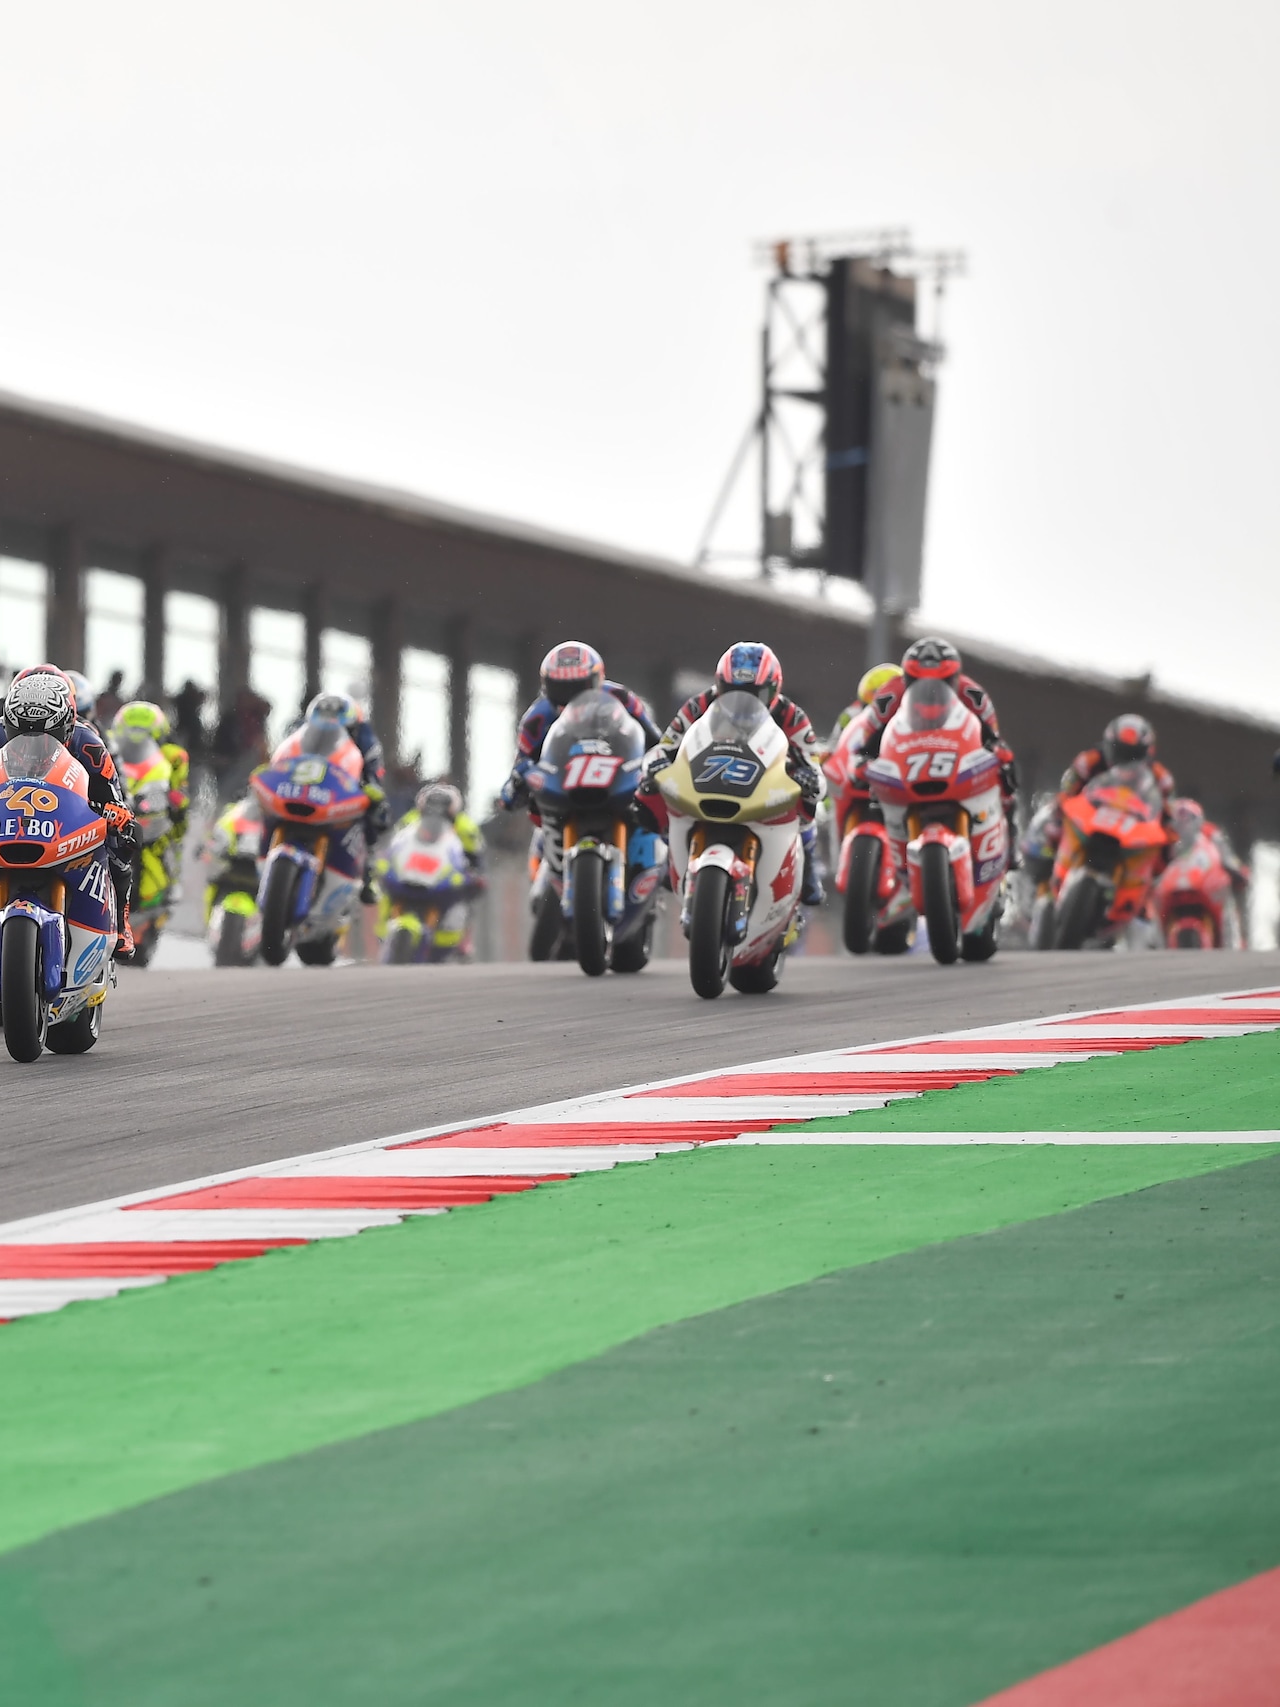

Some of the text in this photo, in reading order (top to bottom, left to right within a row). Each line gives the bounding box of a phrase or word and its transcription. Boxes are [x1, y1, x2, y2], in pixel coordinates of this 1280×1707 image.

[20, 706, 47, 717] X-lite
[6, 777, 47, 786] VITALDENT
[563, 754, 624, 791] 16
[694, 754, 760, 786] 79
[905, 752, 957, 782] 75
[6, 786, 58, 816] 40
[56, 829, 99, 857] STIHL
